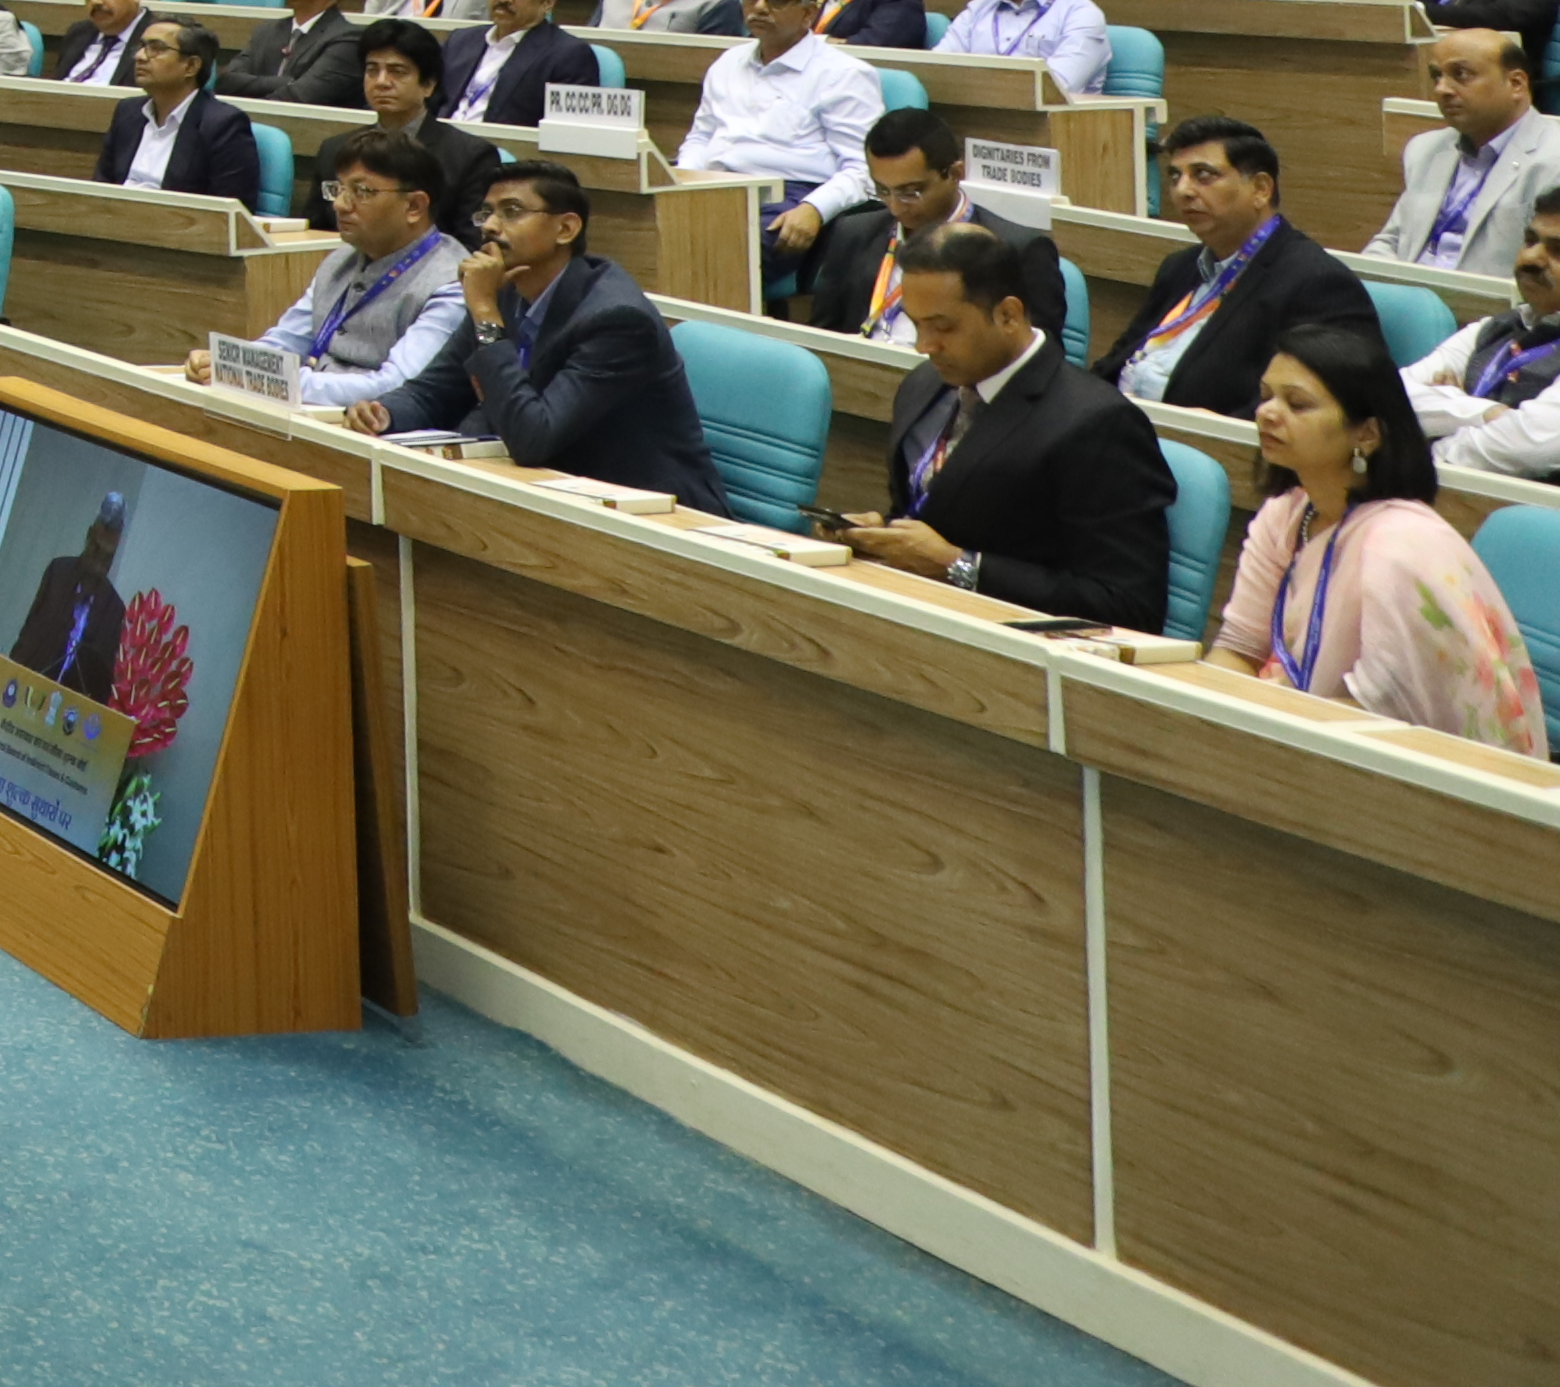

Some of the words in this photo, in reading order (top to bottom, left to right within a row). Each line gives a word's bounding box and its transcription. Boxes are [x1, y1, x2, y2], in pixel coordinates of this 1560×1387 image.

[972, 143, 1025, 165] DIGNITARIES
[1026, 151, 1051, 169] FROM
[981, 164, 1008, 182] TRADE
[1010, 169, 1042, 187] BODIES
[218, 339, 240, 364] SENIOR
[240, 345, 284, 376] MANAGEMENT
